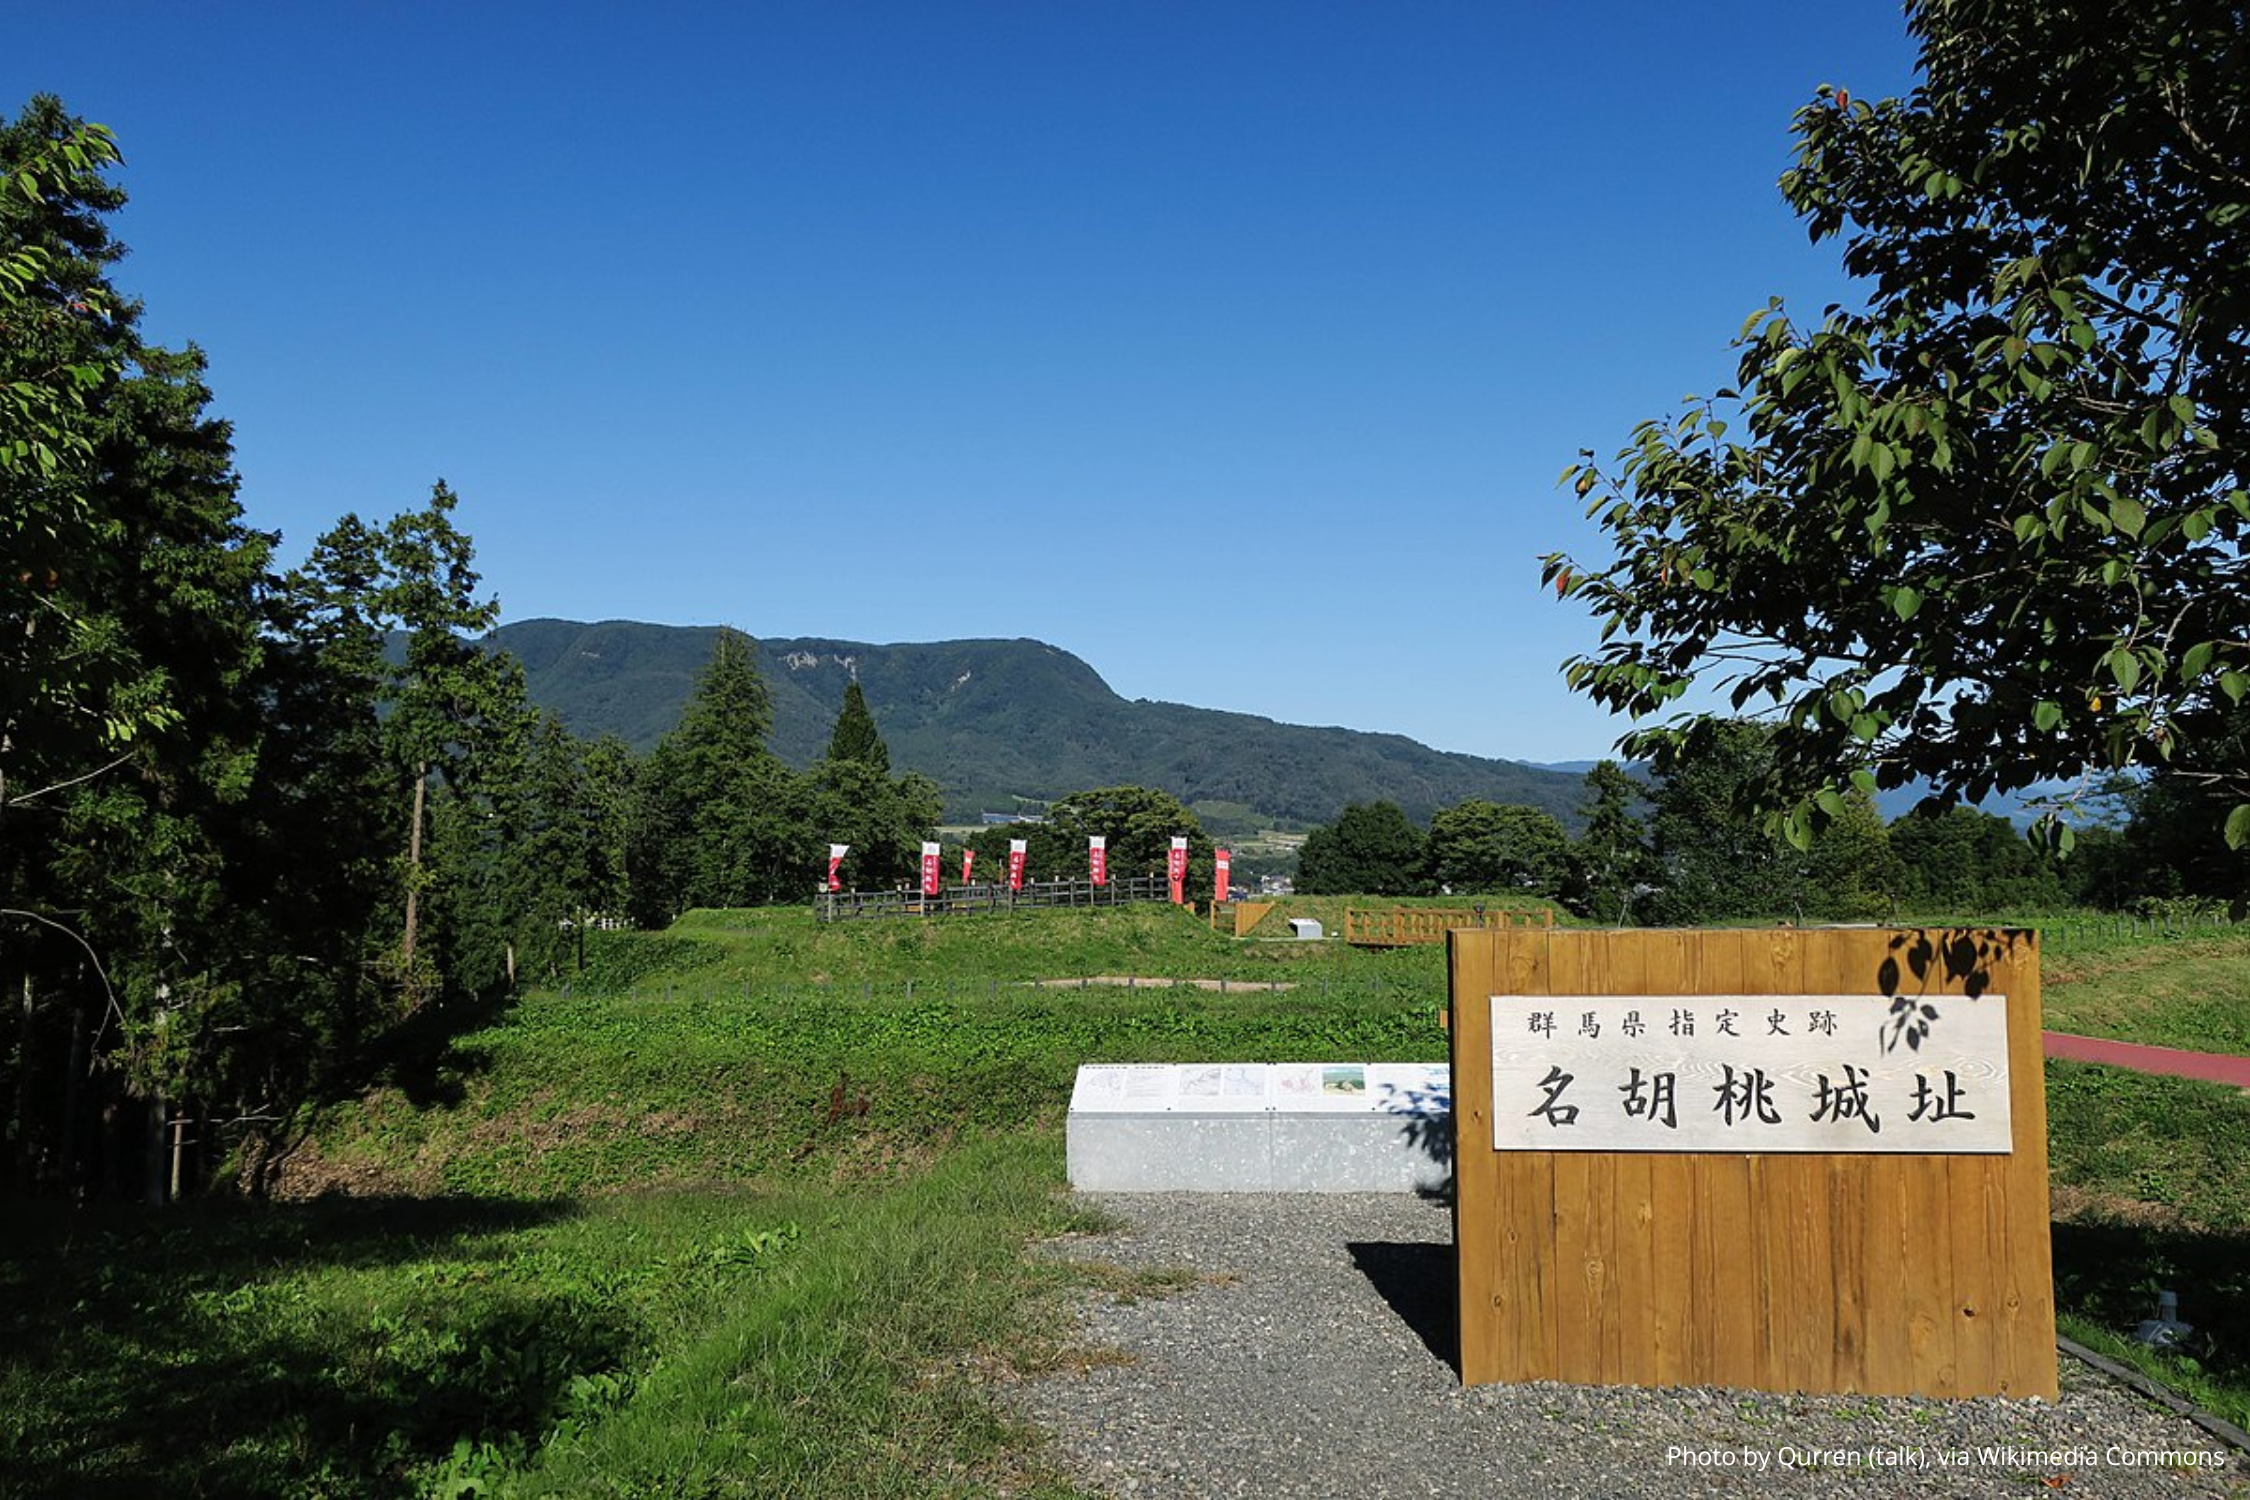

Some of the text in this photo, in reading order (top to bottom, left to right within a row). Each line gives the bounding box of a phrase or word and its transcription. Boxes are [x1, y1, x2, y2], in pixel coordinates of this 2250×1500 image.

[1527, 1008, 1838, 1039] 群馬県指定史跡
[1527, 1063, 1976, 1134] 名胡桃城址
